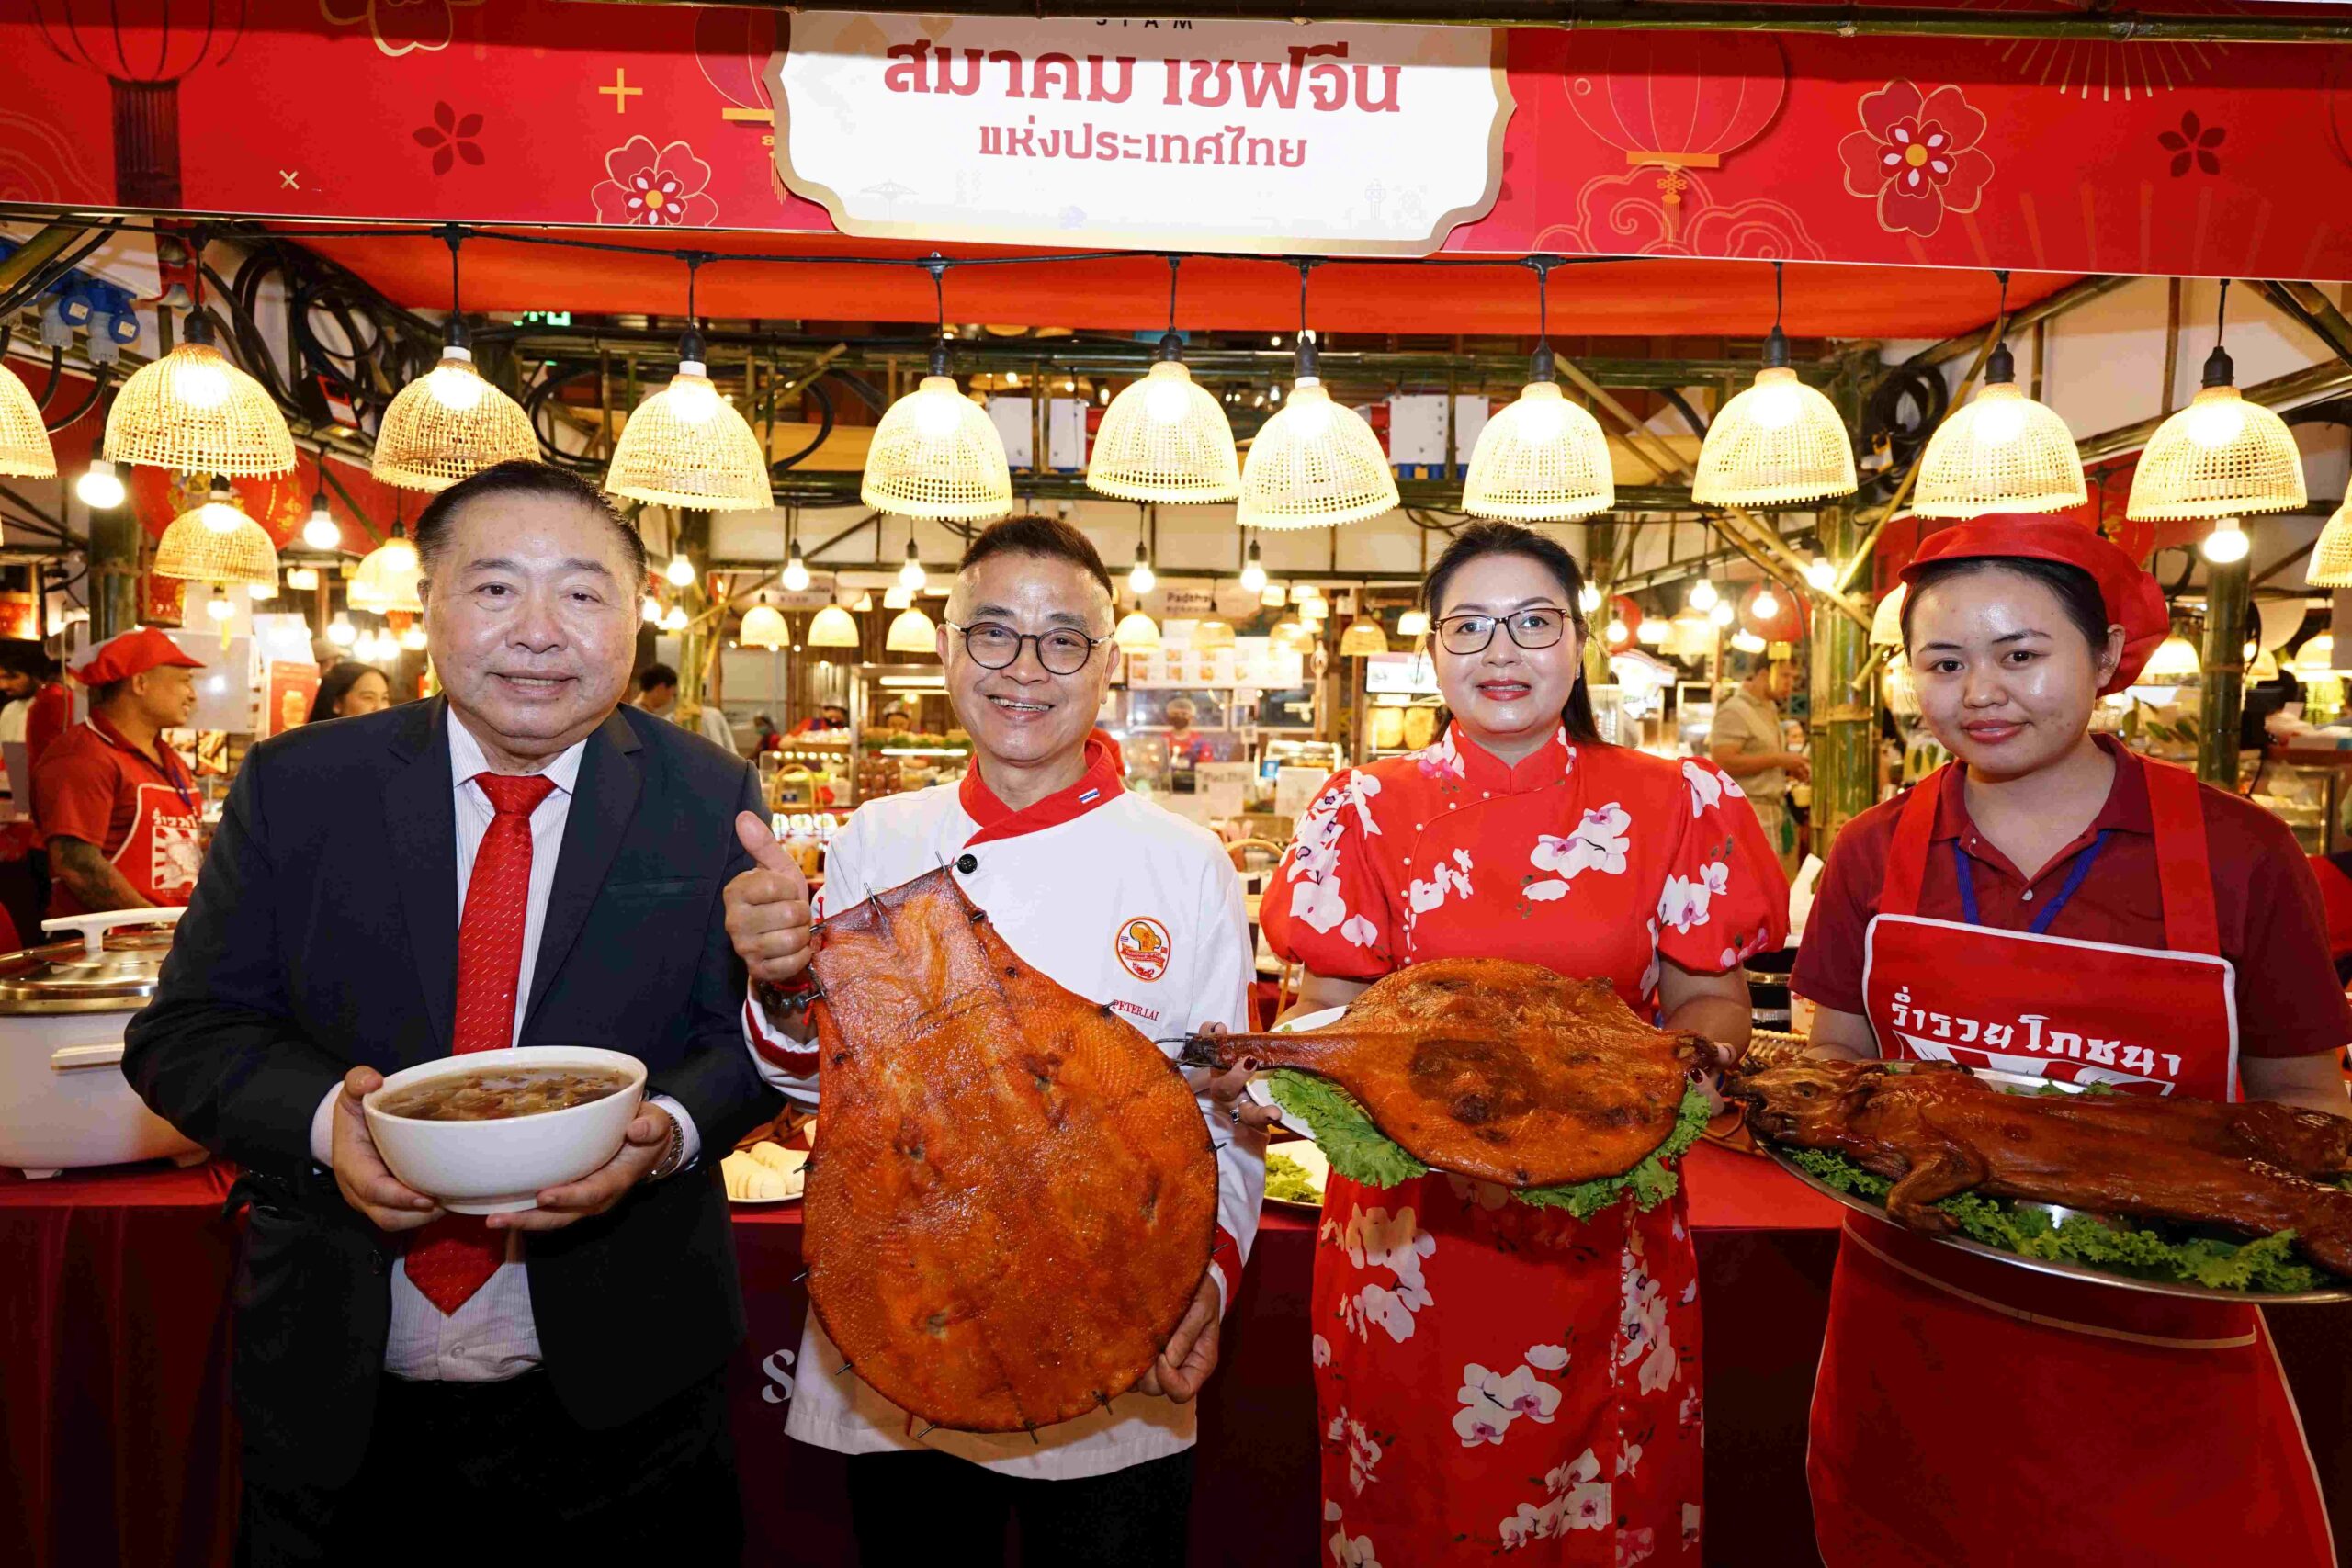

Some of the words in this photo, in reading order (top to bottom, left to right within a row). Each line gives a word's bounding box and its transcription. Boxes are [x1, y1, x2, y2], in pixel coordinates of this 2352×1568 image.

[884, 39, 1136, 104] สมาคม
[1162, 41, 1401, 114] เชฟจีน
[978, 114, 1307, 168] แห่งประเทศไทย
[1891, 986, 2182, 1076] ร่ำรวยโภชนา
